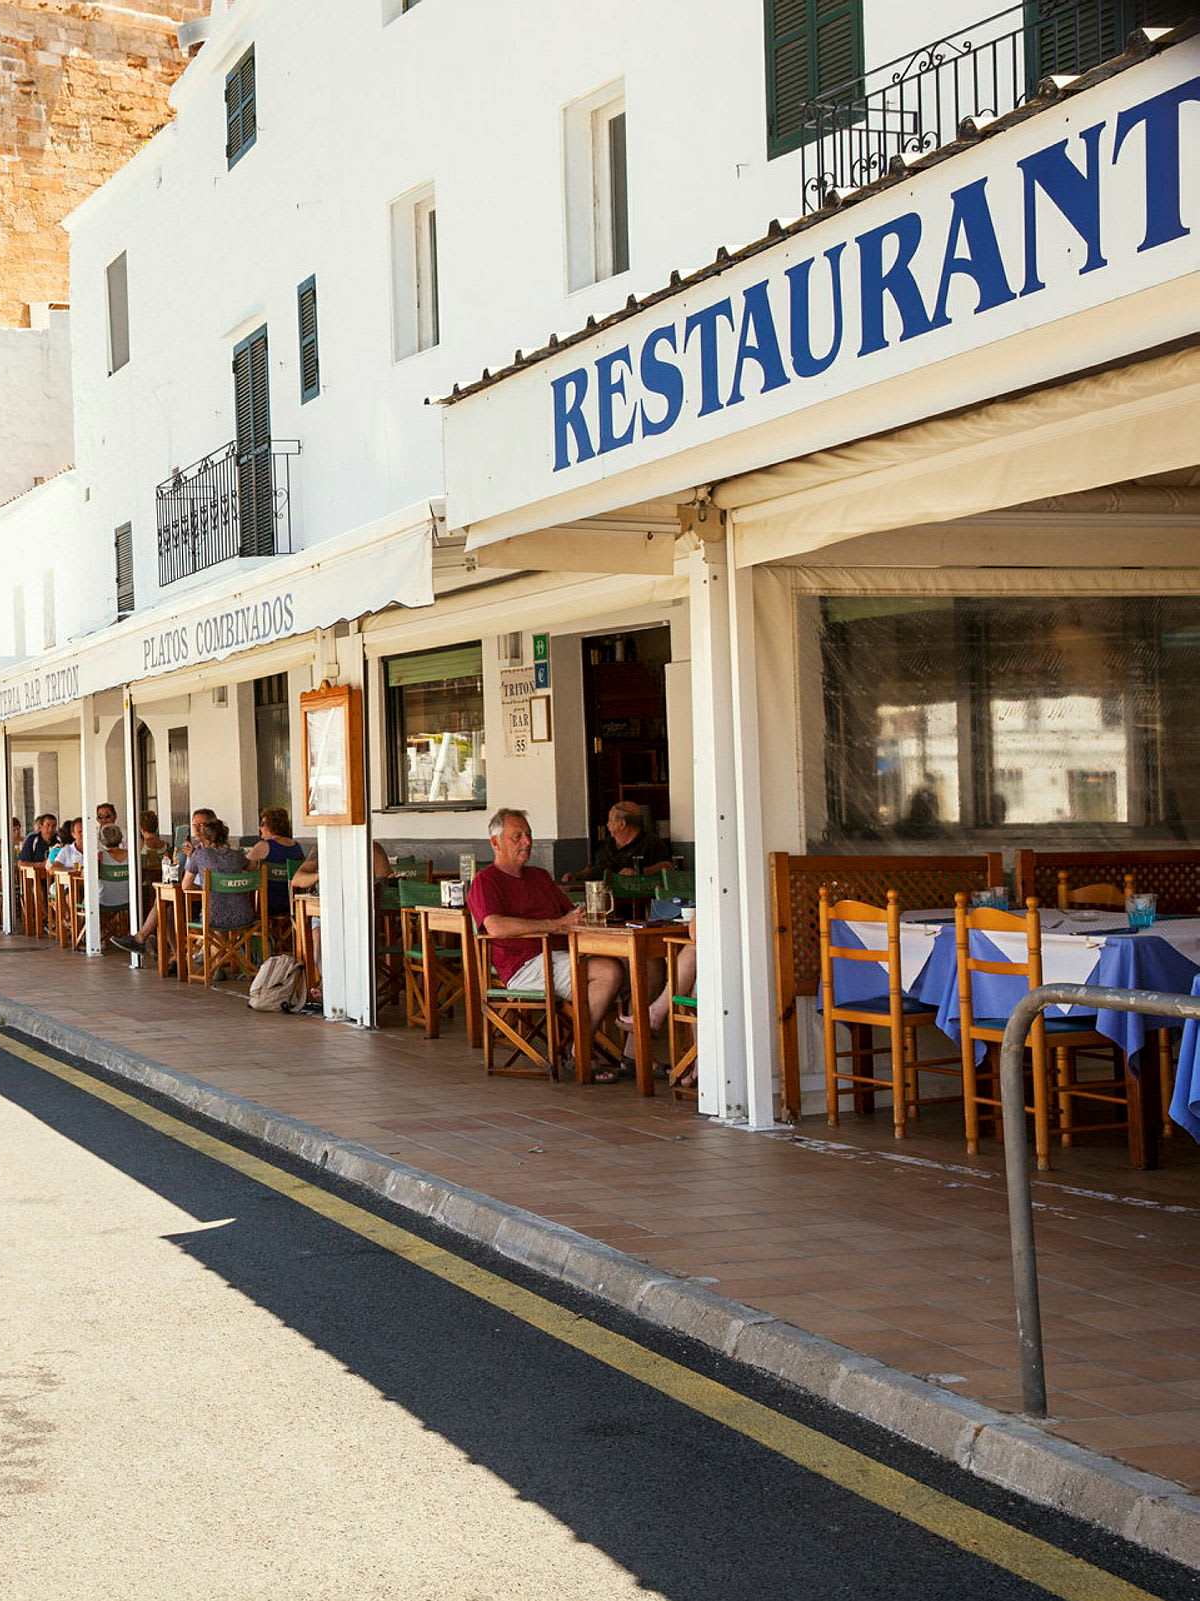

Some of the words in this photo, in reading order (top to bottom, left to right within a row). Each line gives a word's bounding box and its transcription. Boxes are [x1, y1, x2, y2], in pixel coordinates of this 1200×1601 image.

[551, 75, 1200, 472] RESTAURANT
[143, 627, 189, 671] PLATOS
[196, 593, 294, 656] COMBINADOS
[24, 678, 42, 709] BAR
[45, 664, 79, 703] TRITON
[503, 680, 536, 697] TRITON
[511, 713, 529, 728] BAR
[515, 739, 526, 752] 55
